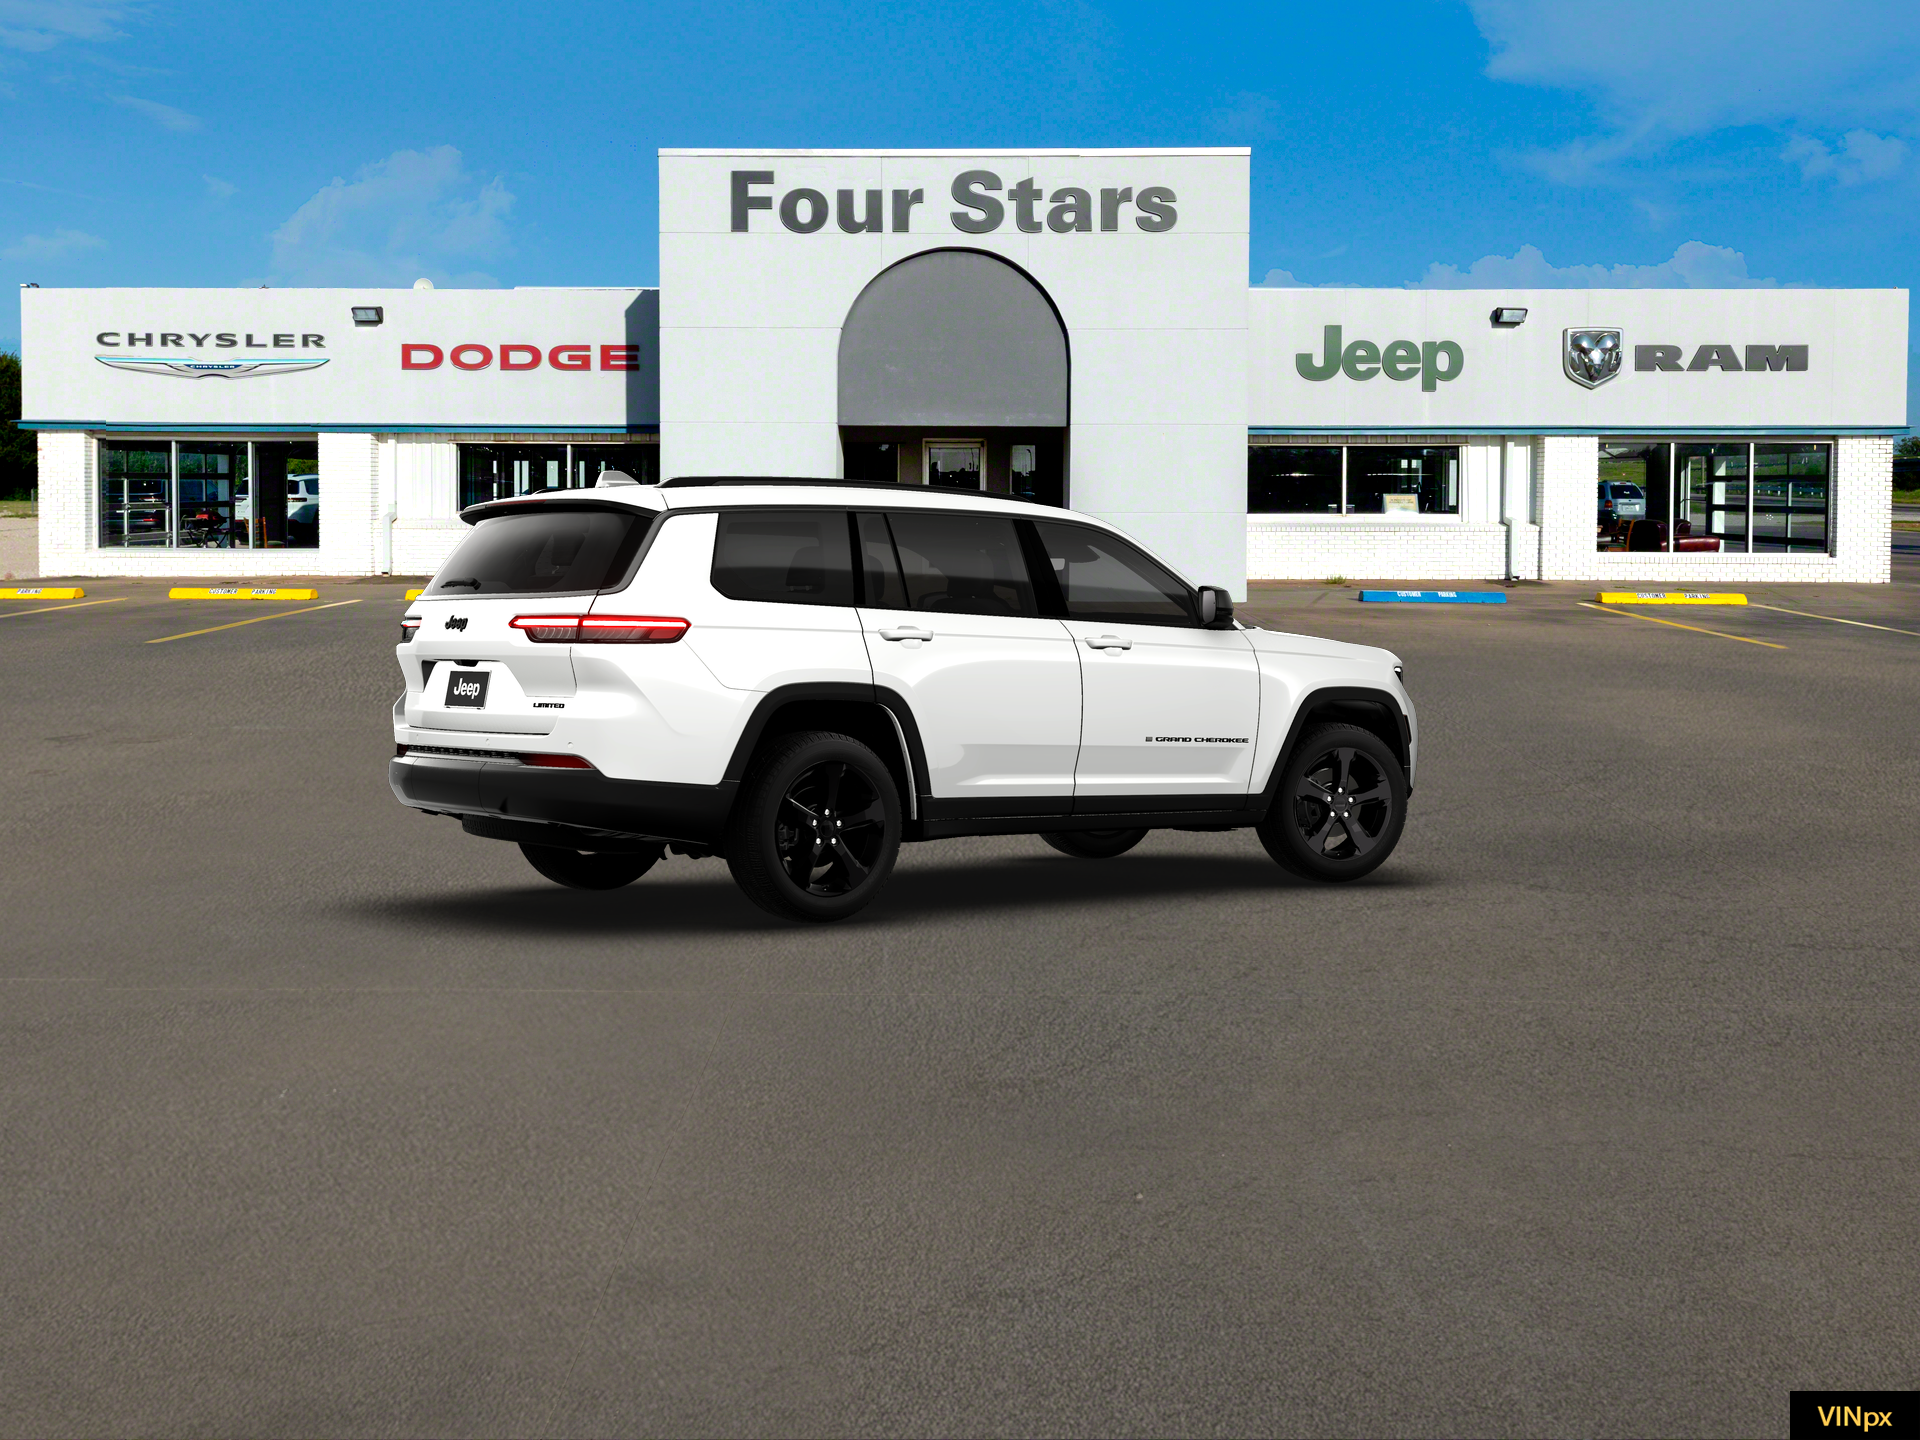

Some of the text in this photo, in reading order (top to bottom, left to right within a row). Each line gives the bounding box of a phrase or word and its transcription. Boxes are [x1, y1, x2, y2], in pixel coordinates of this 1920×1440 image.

[730, 169, 1178, 233] Four Stars
[96, 332, 326, 348] CHRYSLER
[401, 343, 640, 371] DODGE
[1295, 325, 1464, 392] Jeep
[1635, 344, 1809, 371] RAM
[445, 614, 469, 632] Jeep
[453, 678, 480, 699] Jeep
